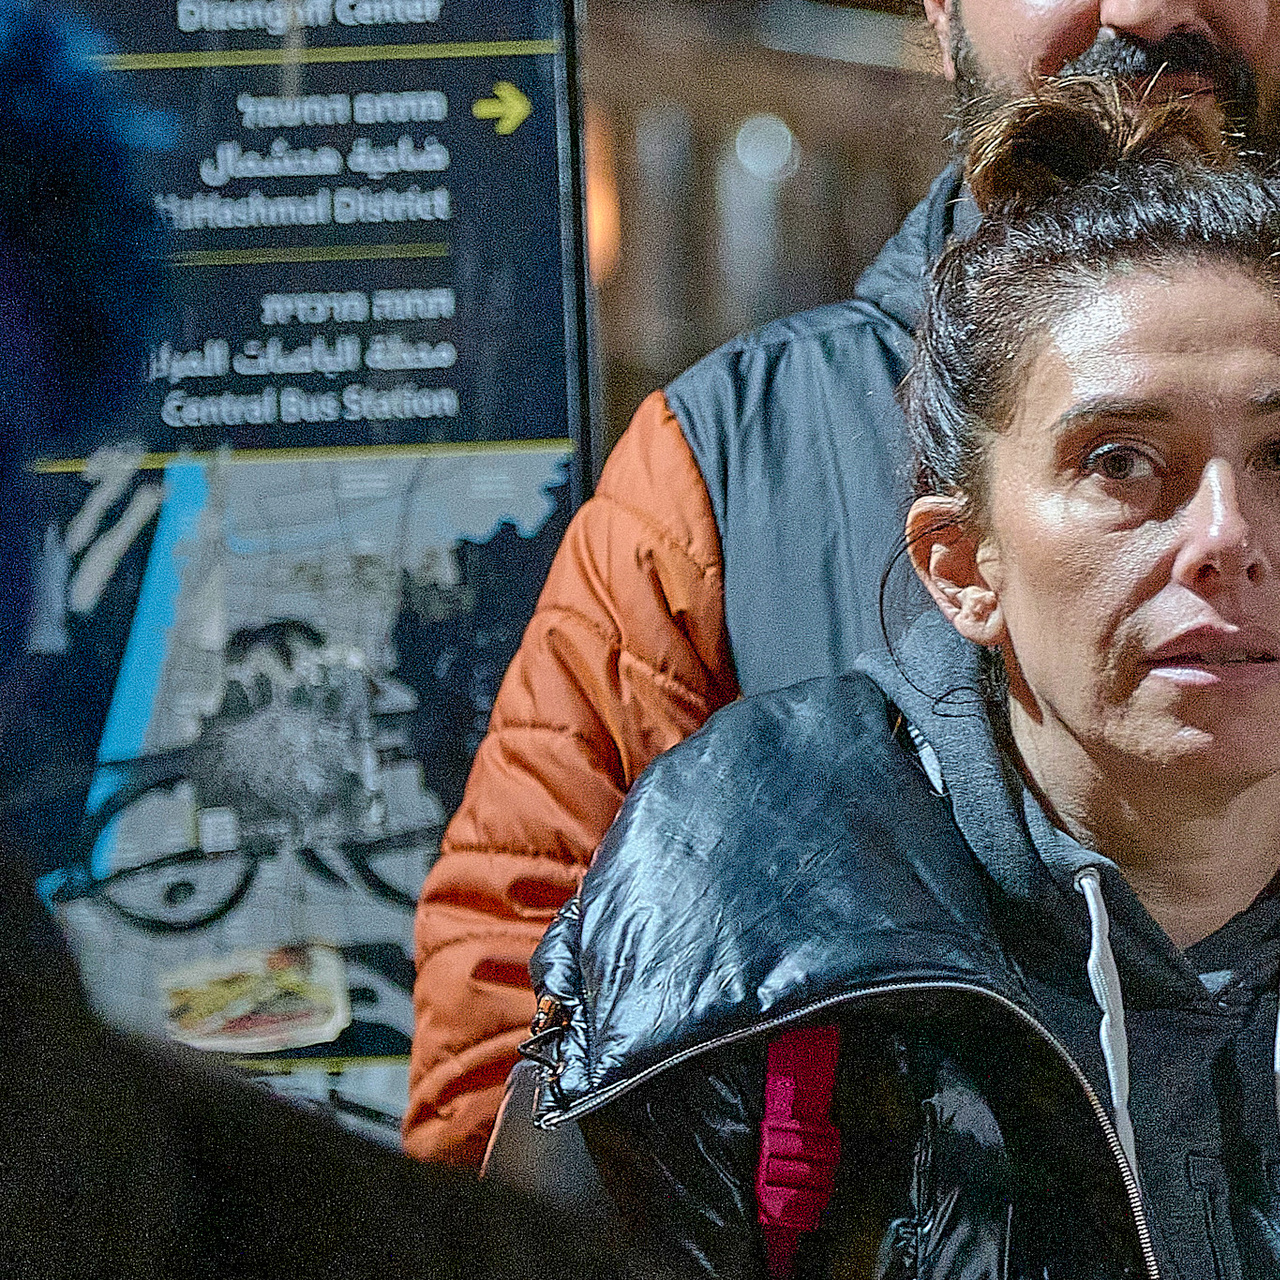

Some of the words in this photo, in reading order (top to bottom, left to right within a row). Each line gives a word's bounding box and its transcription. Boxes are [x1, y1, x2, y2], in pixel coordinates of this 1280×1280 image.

[237, 92, 351, 128] החשמל
[354, 91, 447, 124] מתחם
[334, 185, 451, 224] District
[372, 288, 456, 320] תחנה
[162, 386, 277, 427] Central
[280, 386, 339, 423] Bus
[342, 383, 460, 421] Station
